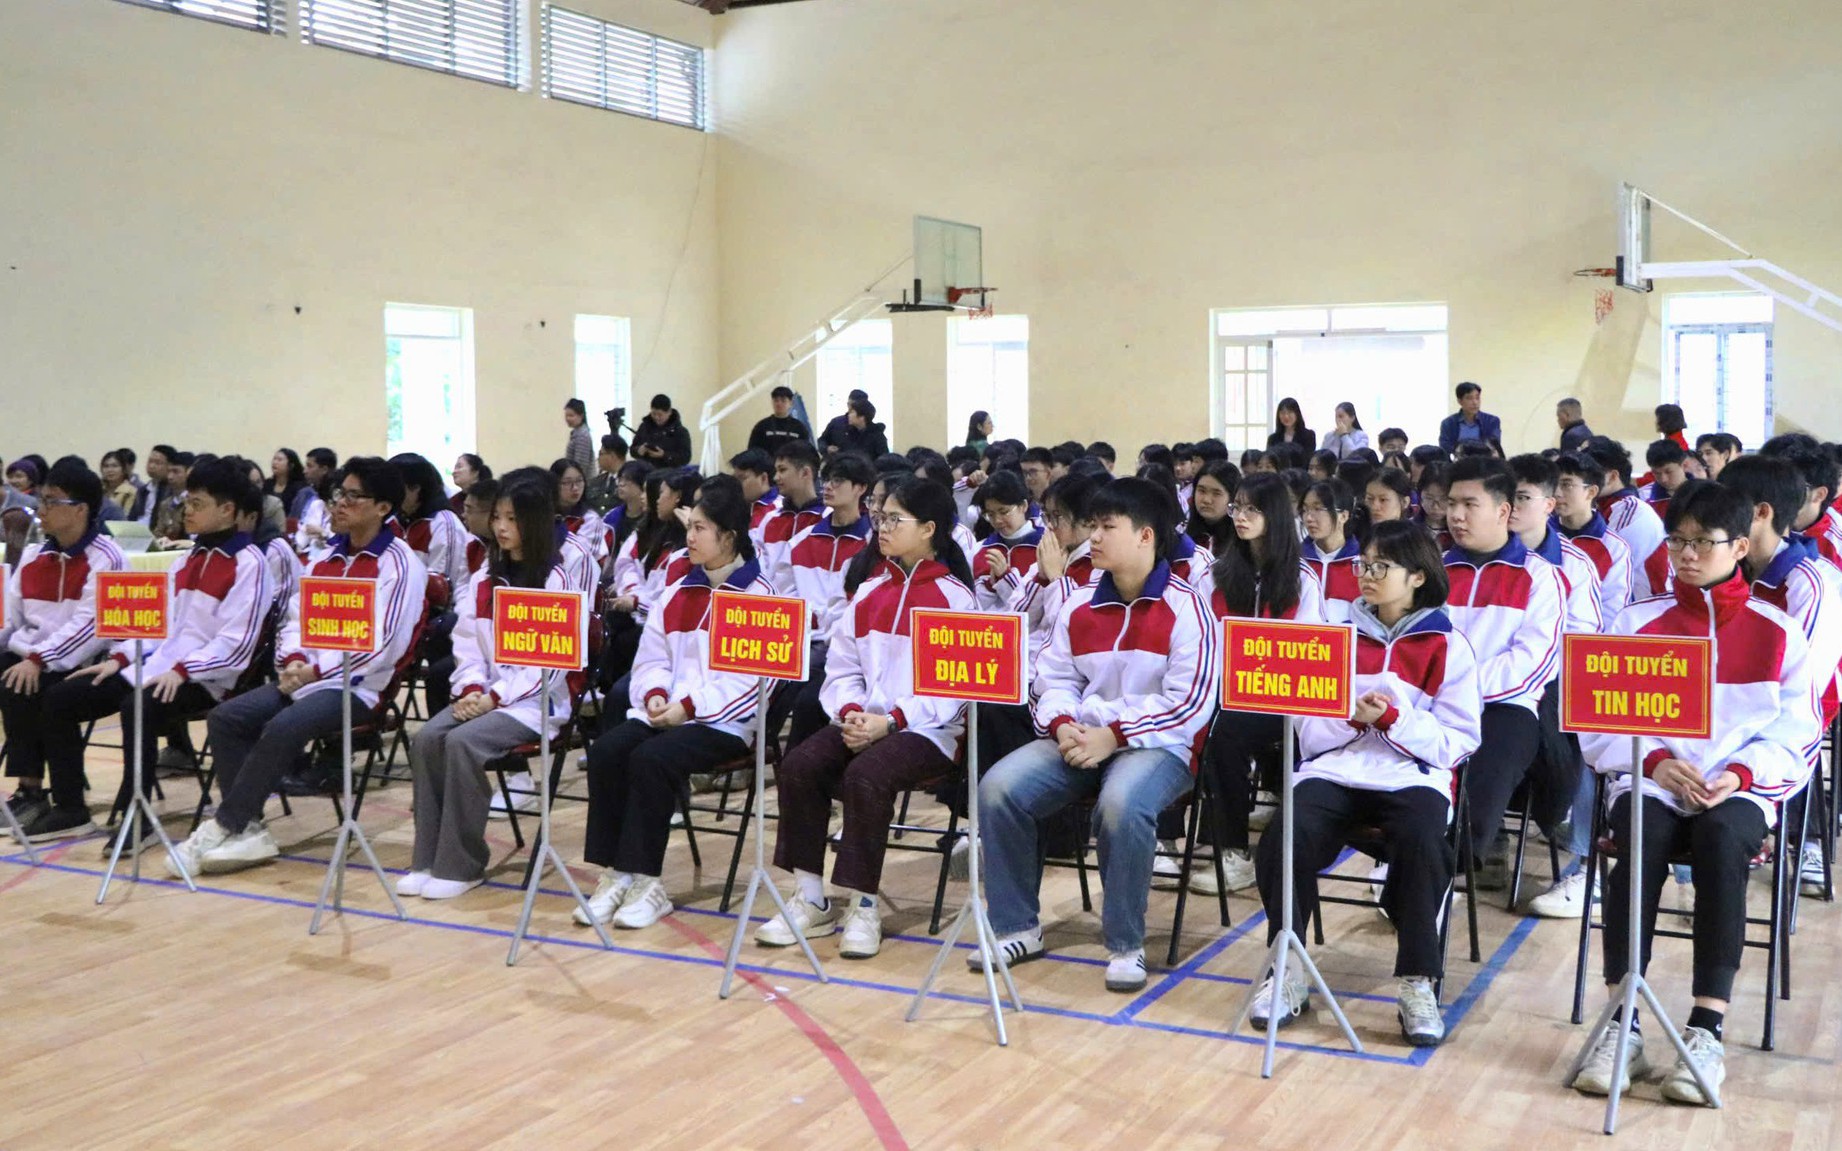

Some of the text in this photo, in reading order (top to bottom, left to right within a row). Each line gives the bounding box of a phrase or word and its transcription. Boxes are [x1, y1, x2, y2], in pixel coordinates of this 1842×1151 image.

[312, 590, 364, 609] ĐỘI TUYỂN
[508, 602, 567, 623] ĐỘI TUYỂN
[726, 606, 790, 629] ĐỘI TUYỂN
[308, 618, 369, 642] SINH HỌC
[503, 628, 573, 655] NGỮ VĂN
[929, 625, 1003, 649] ĐỘI TUYỂN
[721, 634, 794, 664] LỊCH SỬ
[1243, 636, 1330, 661] ĐỘI TUYỂN
[935, 659, 999, 687] ĐỊA LÝ
[1586, 651, 1687, 677] ĐỘI TUYỂN
[1236, 664, 1338, 700] TIẾNG ANH
[1592, 690, 1681, 724] TIN HỌC
